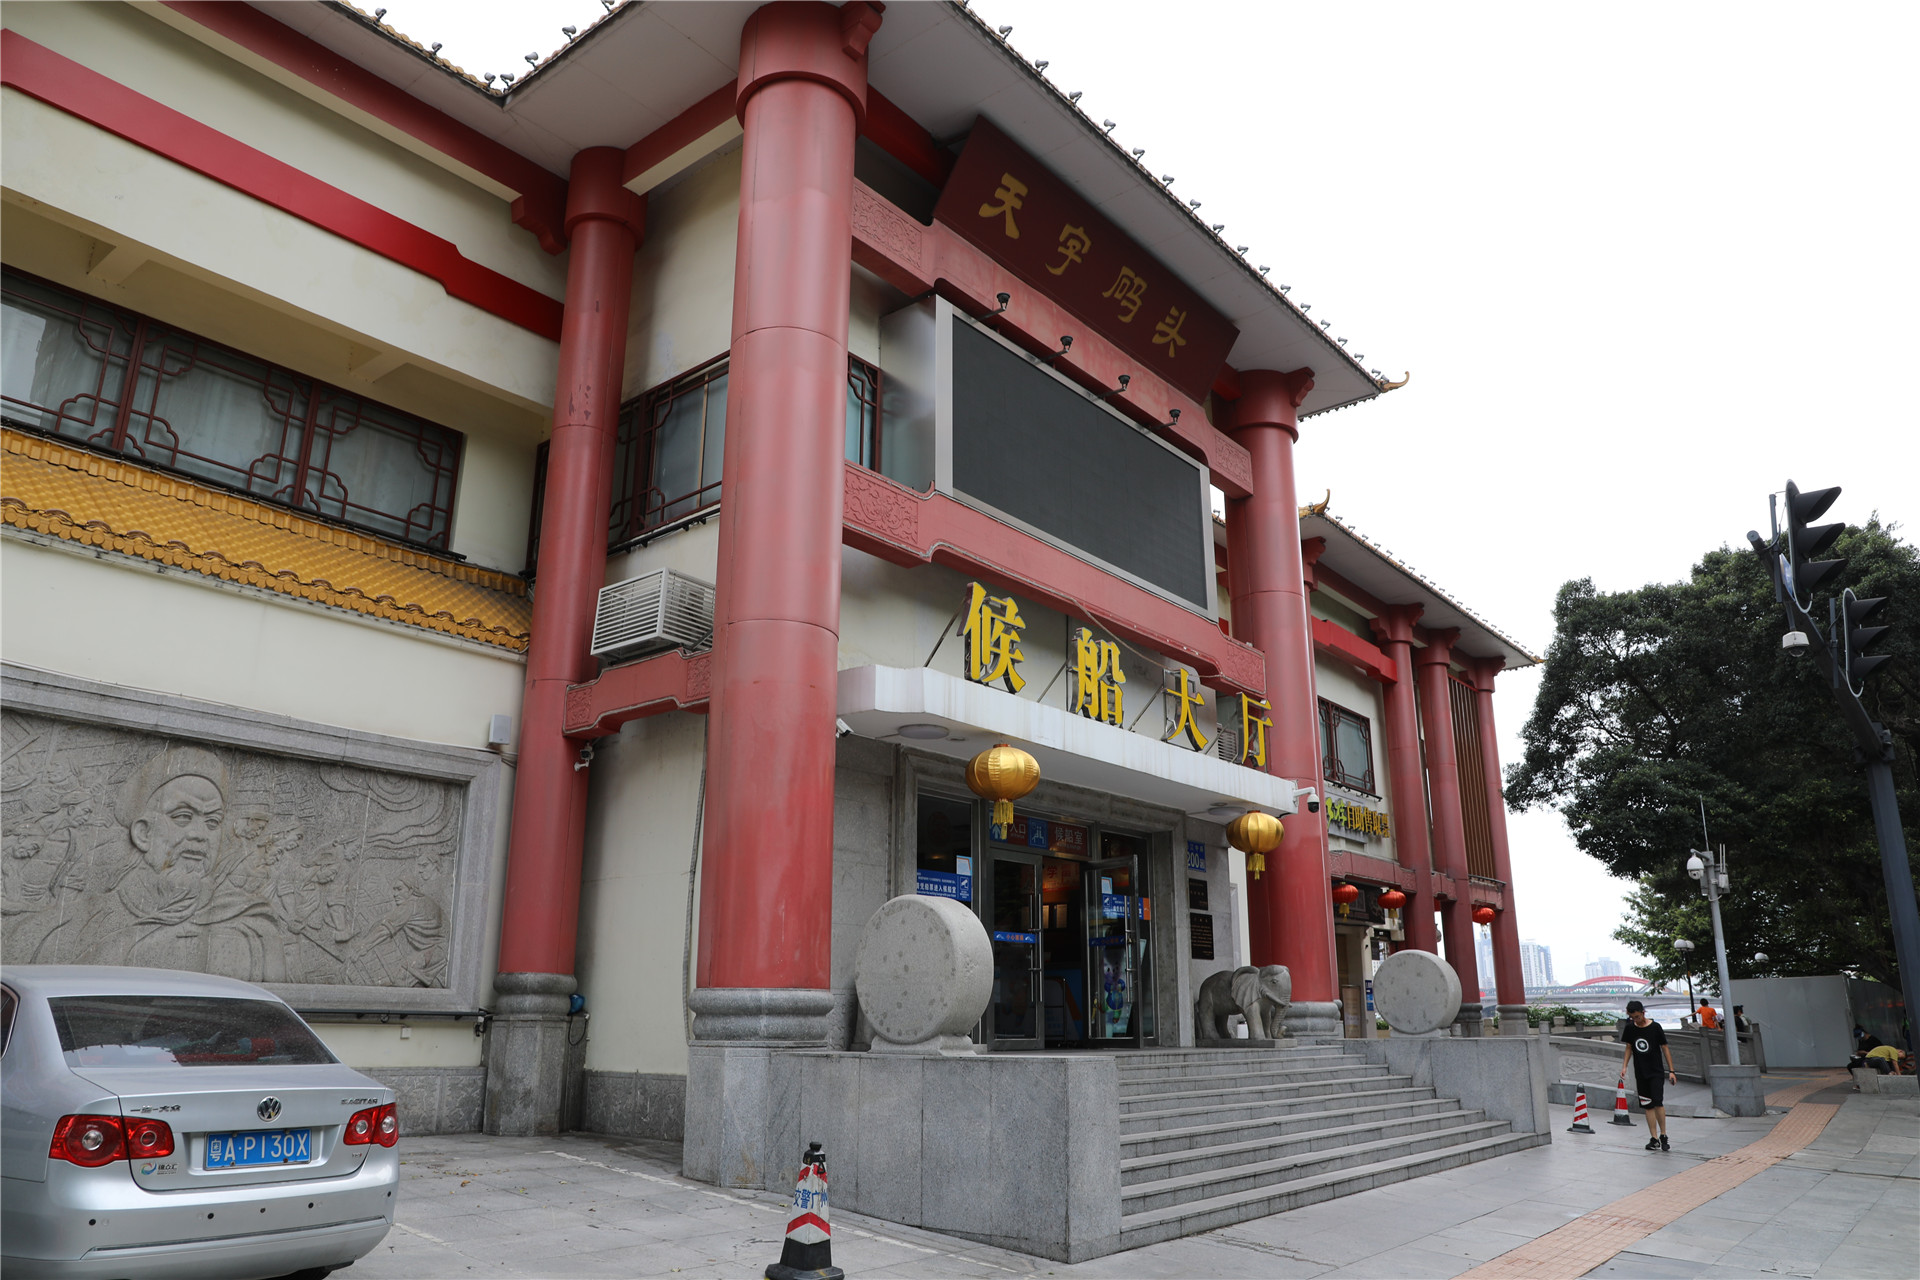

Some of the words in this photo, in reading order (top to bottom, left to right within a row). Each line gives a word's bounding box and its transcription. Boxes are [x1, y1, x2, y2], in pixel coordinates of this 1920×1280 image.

[978, 172, 1187, 358] 天字码头
[957, 581, 1274, 767] 候船大厅
[1009, 823, 1026, 834] 入口
[1055, 826, 1083, 845] 候船室
[1187, 851, 1200, 868] 200
[209, 1133, 308, 1162] 粤A·P130X
